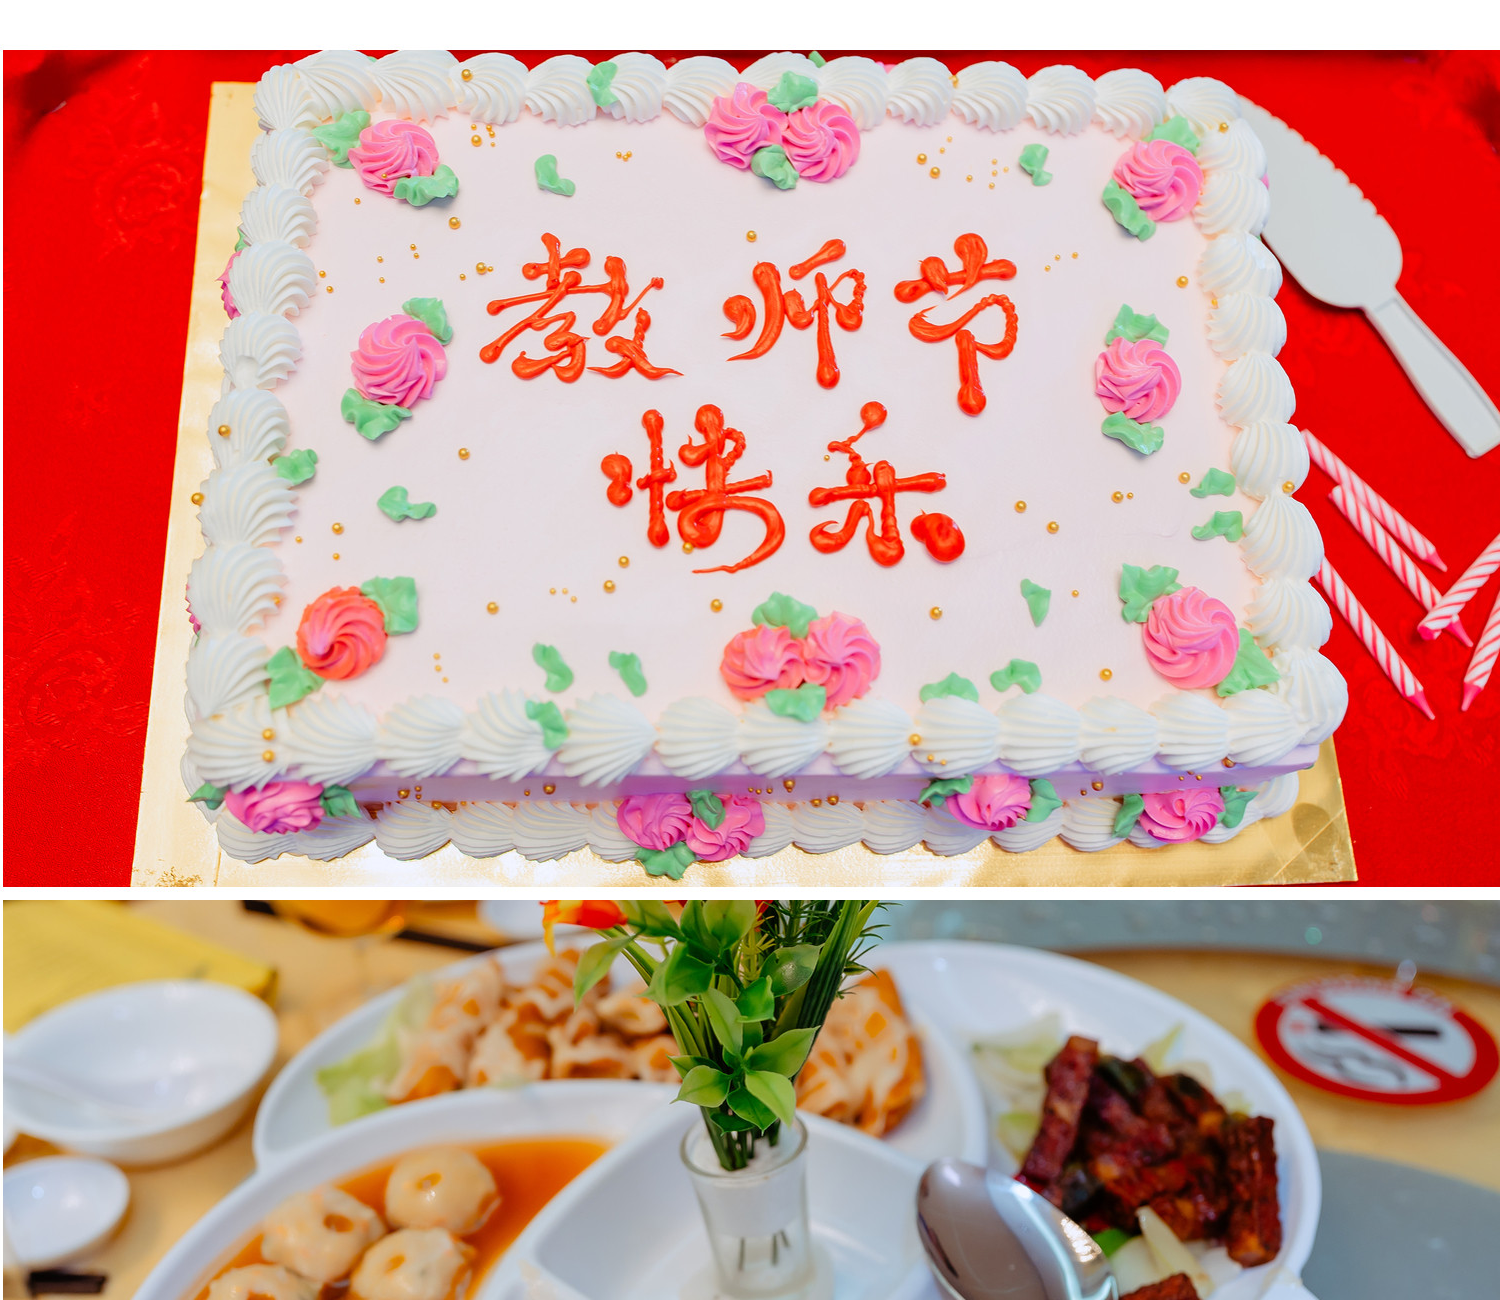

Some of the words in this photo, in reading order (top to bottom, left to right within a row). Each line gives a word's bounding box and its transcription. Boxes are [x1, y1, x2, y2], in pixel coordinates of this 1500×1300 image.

[479, 232, 1017, 417] 教师节
[600, 401, 965, 575] 快乐
